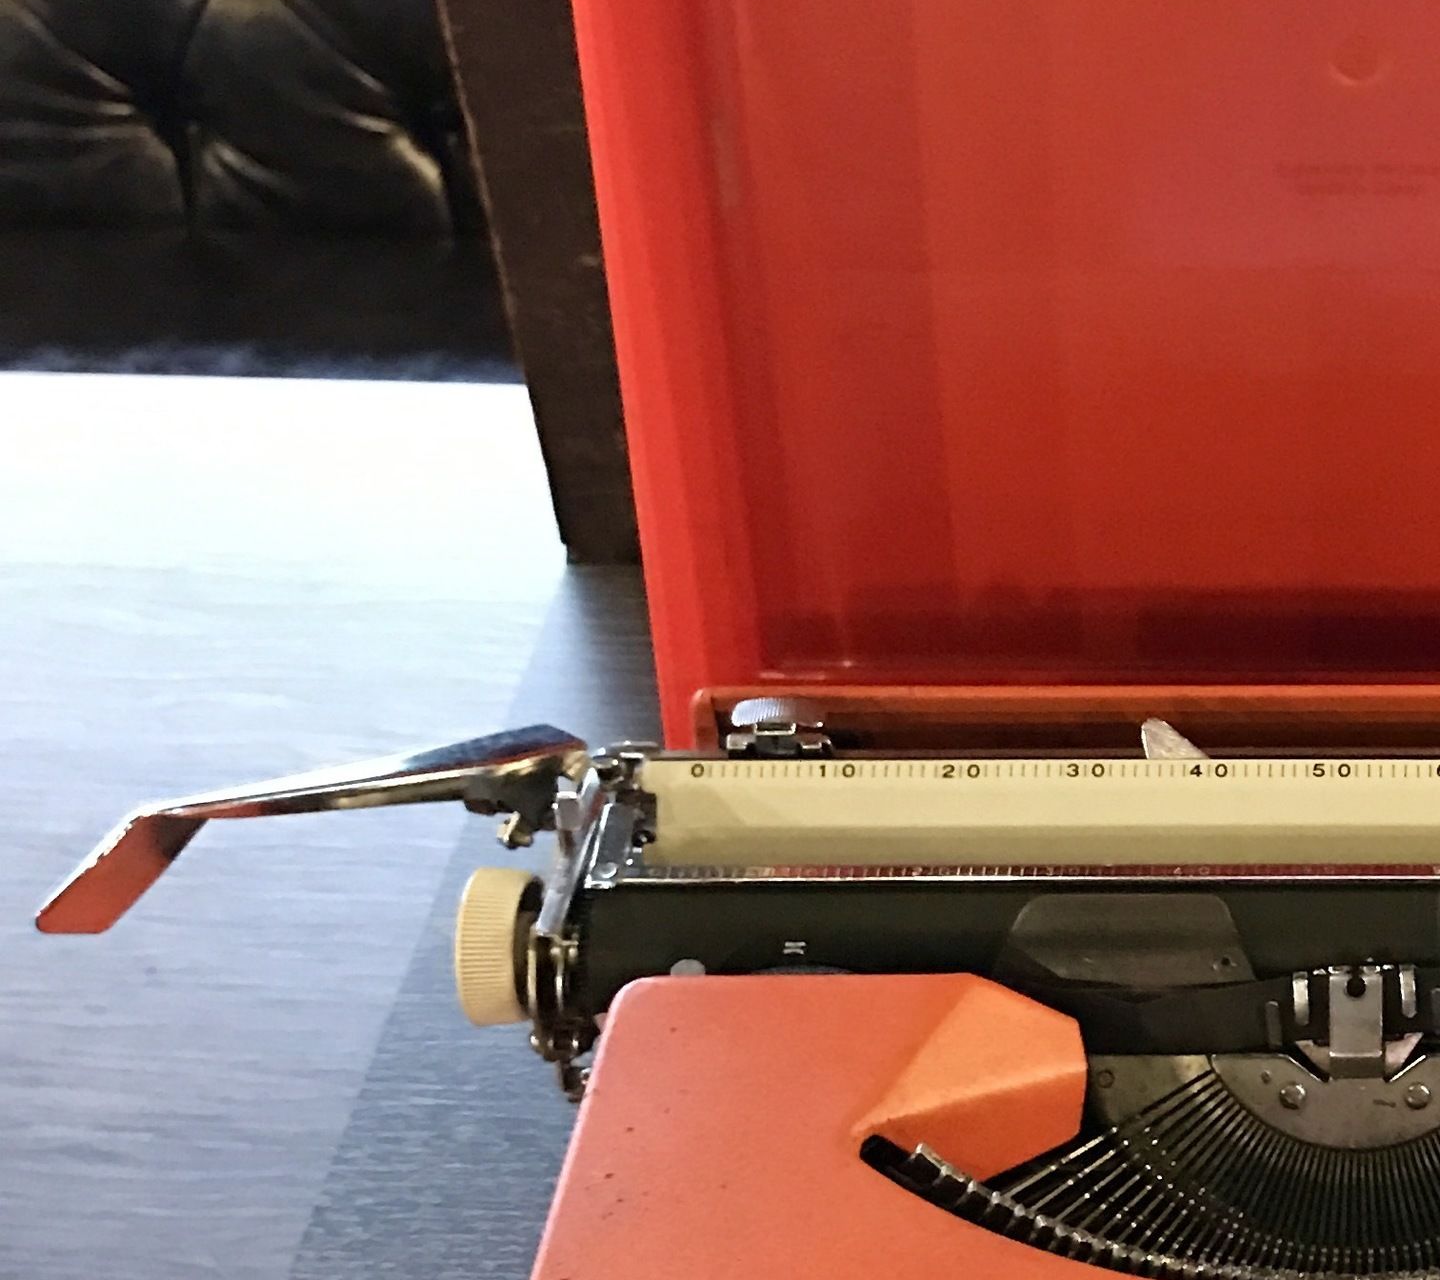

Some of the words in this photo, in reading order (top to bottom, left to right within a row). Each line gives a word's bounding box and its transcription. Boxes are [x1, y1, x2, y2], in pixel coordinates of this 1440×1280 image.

[690, 763, 705, 779] 0
[819, 763, 856, 779] 10
[941, 763, 981, 779] 20
[1066, 762, 1106, 778] 30
[1188, 763, 1229, 779] 40
[1312, 762, 1352, 778] 50
